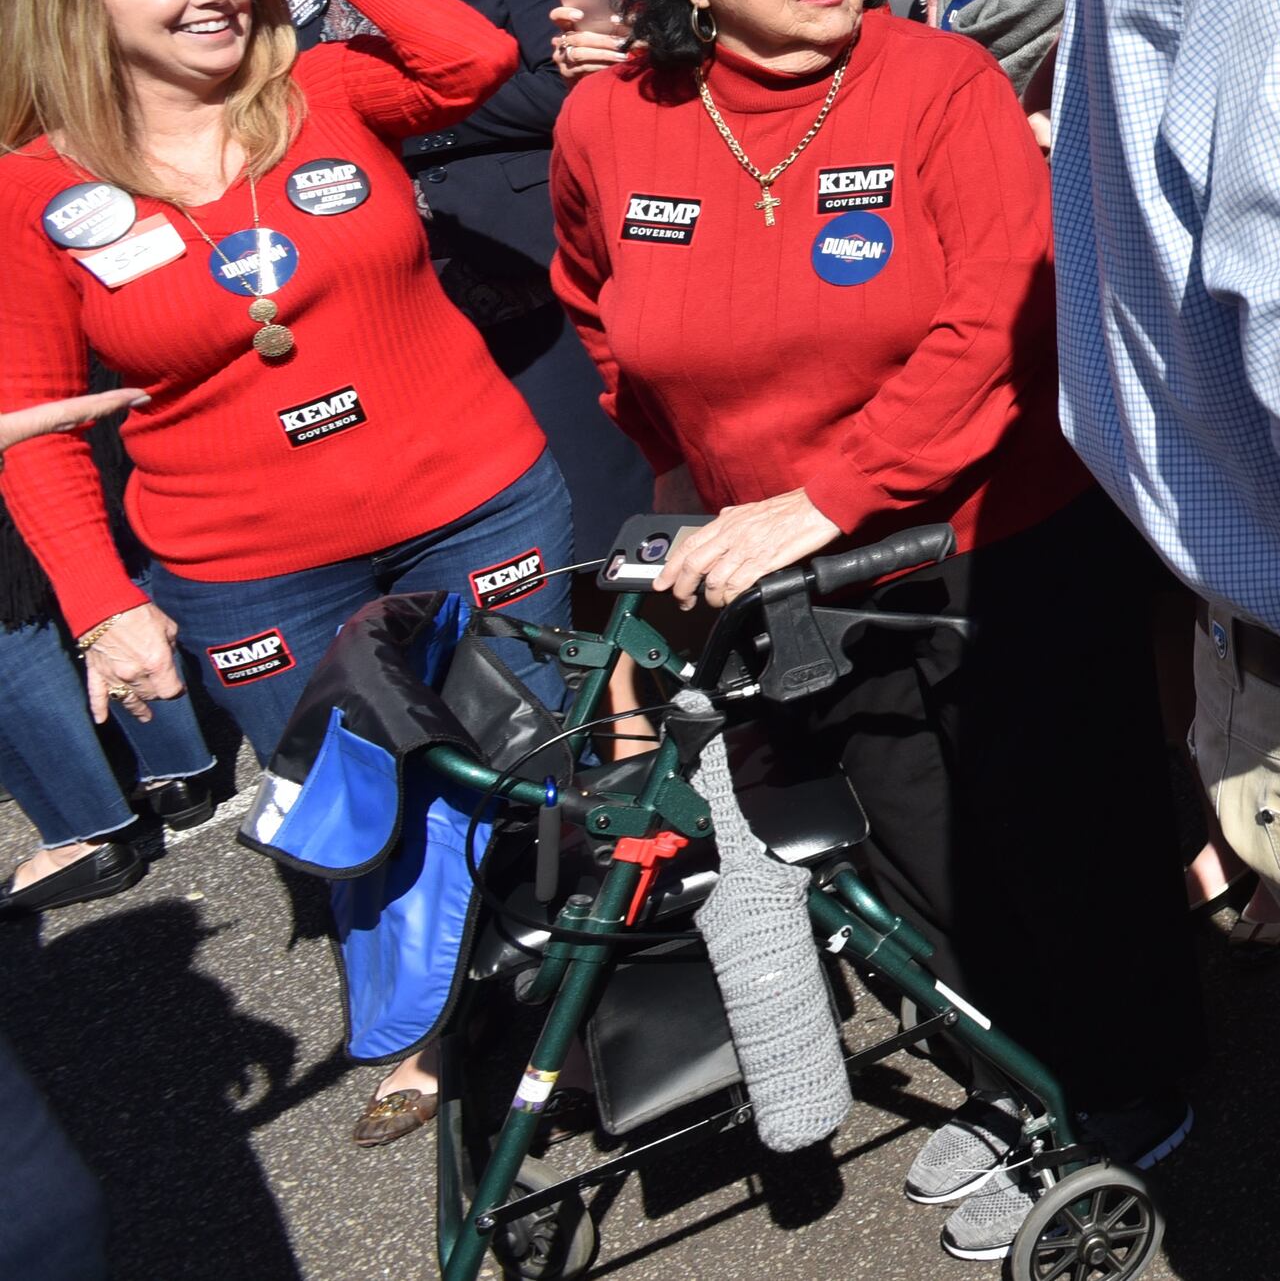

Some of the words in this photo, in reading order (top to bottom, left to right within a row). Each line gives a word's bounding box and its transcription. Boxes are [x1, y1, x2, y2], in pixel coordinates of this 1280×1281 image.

[292, 164, 356, 190] KEMP
[819, 169, 894, 194] KEMP
[299, 181, 362, 200] GOVERNOR
[825, 196, 884, 208] GOVERNOR
[46, 185, 112, 230] KEMP
[626, 198, 701, 226] KEMP
[629, 226, 685, 240] GOVERNOR
[821, 237, 884, 260] DUNCAN
[280, 390, 358, 432] KEMP
[297, 414, 358, 440] GOVERNOR
[474, 555, 540, 594] KEMP
[211, 636, 281, 669] KEMP
[227, 659, 281, 679] GOVERNOR
